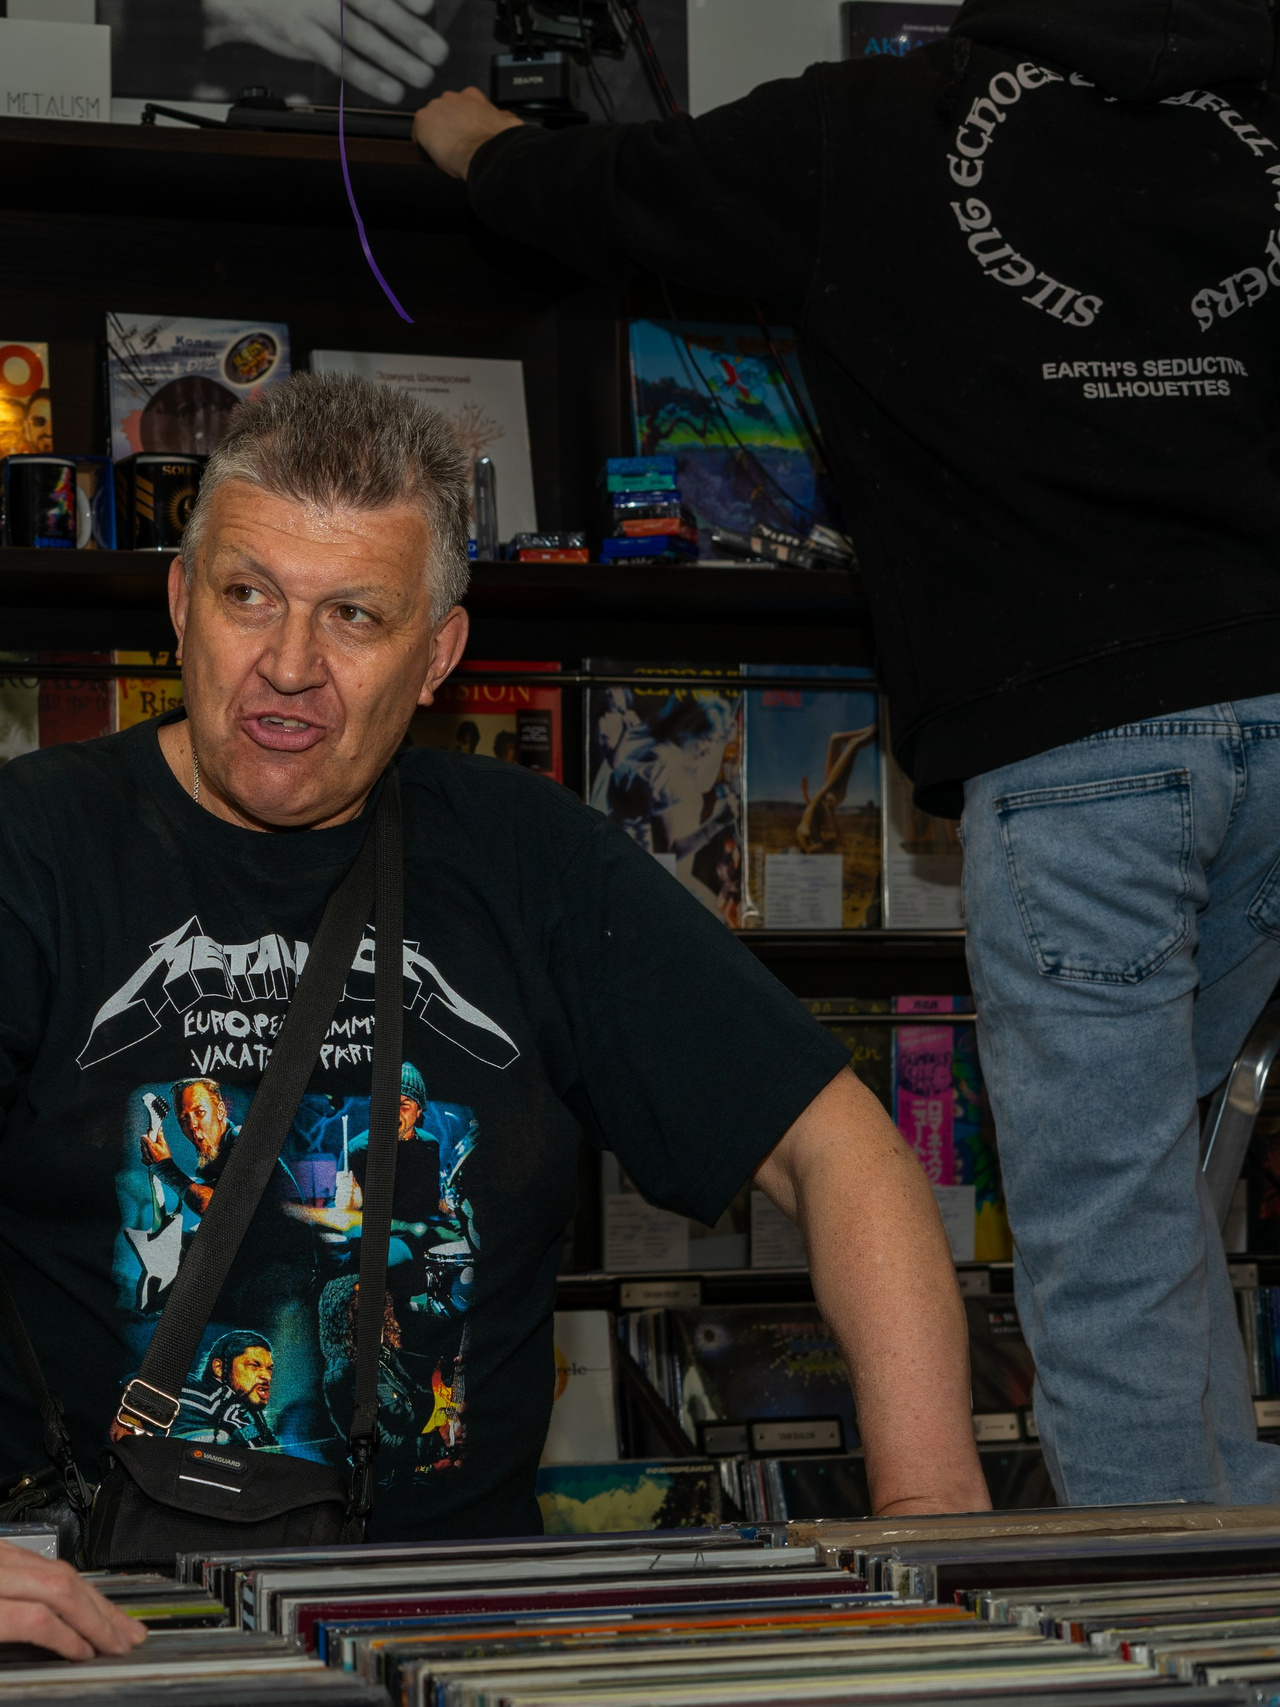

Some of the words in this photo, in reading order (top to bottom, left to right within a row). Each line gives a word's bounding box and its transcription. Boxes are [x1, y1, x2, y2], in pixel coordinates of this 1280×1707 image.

[6, 90, 101, 120] METALISM
[1041, 360, 1138, 381] EARTH'S
[1142, 355, 1249, 379] SEDUCTIVE
[1082, 378, 1232, 400] SILHOUETTES
[184, 1010, 286, 1042] EUROPE
[191, 1042, 272, 1075] VACAT
[320, 1043, 374, 1071] PART
[202, 1451, 242, 1468] VANGUARD
